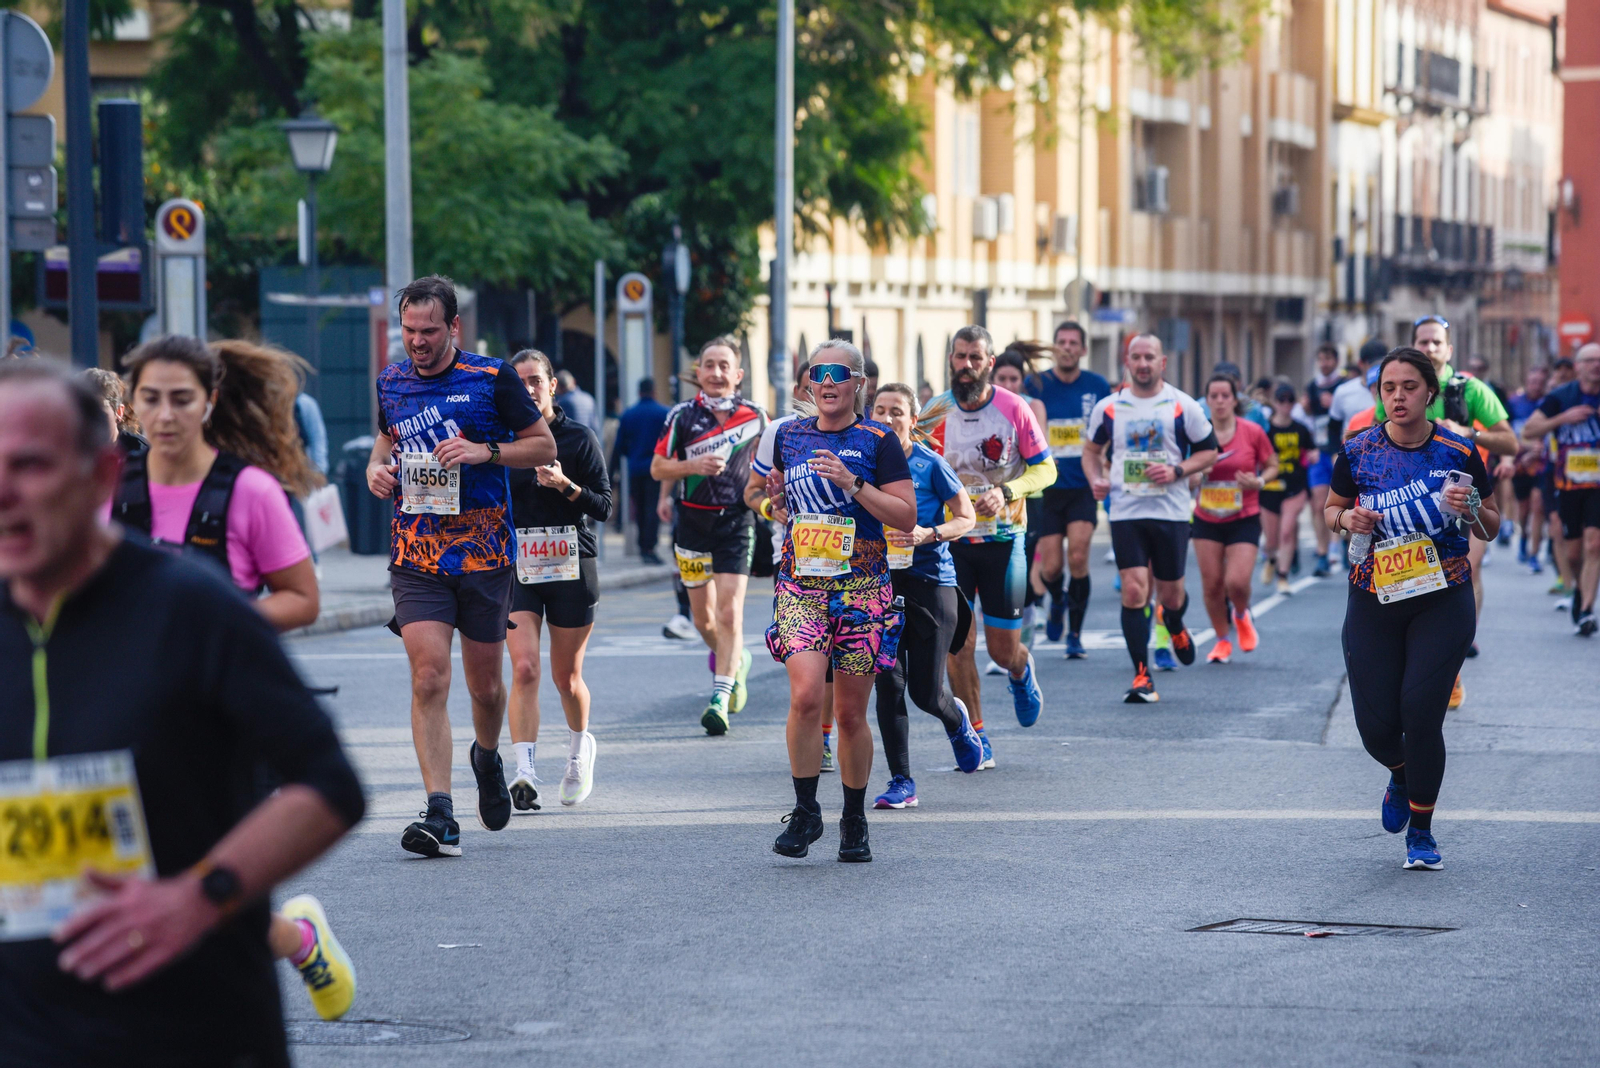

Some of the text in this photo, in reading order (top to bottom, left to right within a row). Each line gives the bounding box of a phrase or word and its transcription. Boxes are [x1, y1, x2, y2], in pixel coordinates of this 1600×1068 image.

[446, 394, 470, 403] HOKA
[393, 405, 443, 440] MARATÓN
[838, 449, 862, 459] HOKA
[406, 467, 448, 486] 14556
[1429, 469, 1451, 478] HOK
[1377, 479, 1429, 509] MARATÓN
[826, 514, 847, 526] SEVILLA
[795, 527, 843, 549] 12775
[1376, 532, 1423, 549] MARATÓN SEVILLA
[521, 540, 568, 558] 14410
[1374, 545, 1427, 576] 12074
